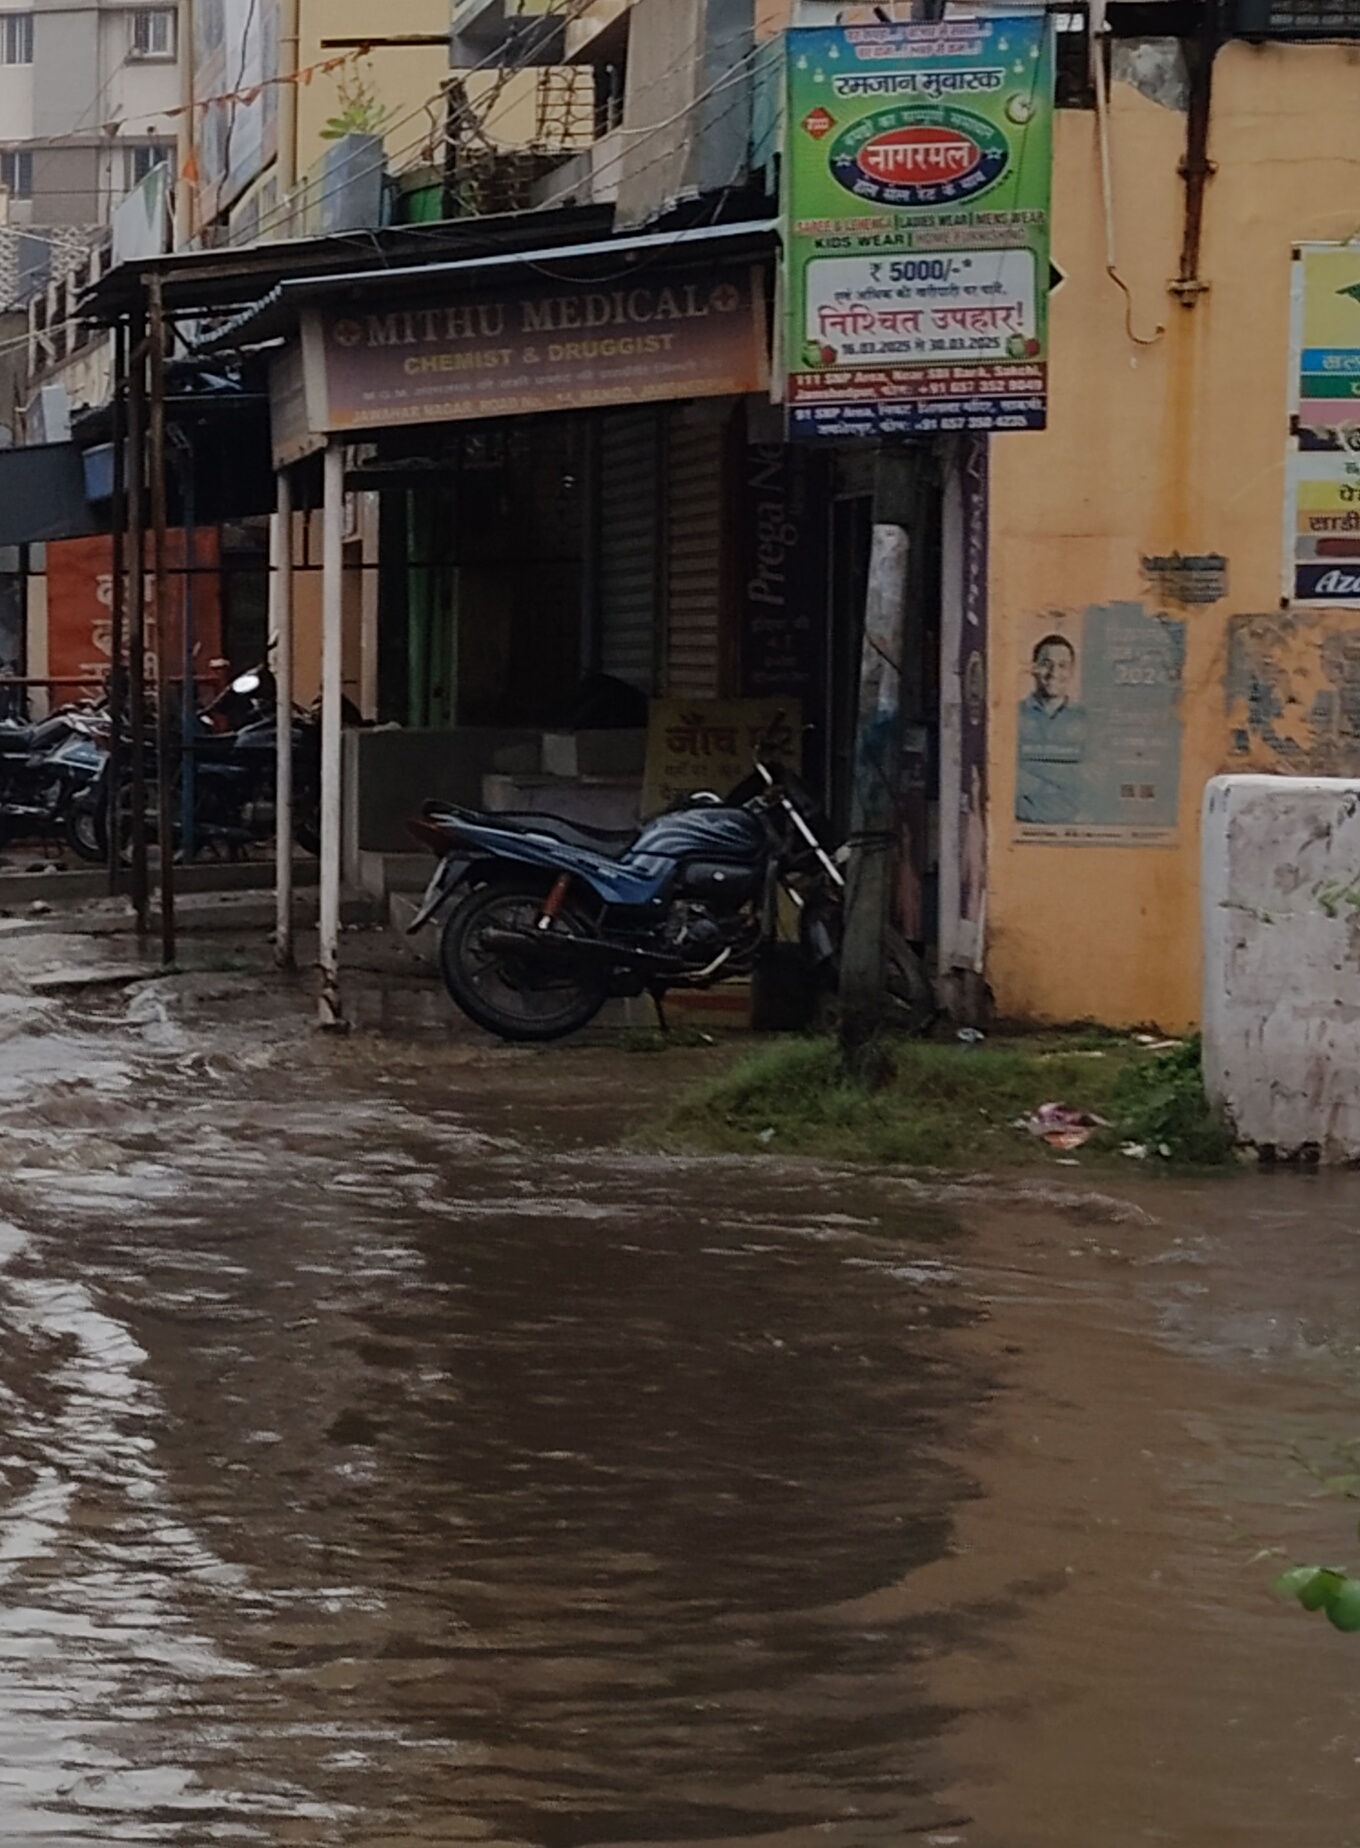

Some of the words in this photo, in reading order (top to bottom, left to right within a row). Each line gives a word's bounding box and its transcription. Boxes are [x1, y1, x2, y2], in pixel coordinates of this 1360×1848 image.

[866, 141, 972, 171] नागरमल
[938, 214, 966, 227] WEAR
[1011, 210, 1045, 224] WEAR
[814, 236, 851, 249] KIDS
[857, 233, 905, 247] WEAR
[365, 302, 505, 348] MITHU
[521, 284, 709, 333] MEDICAL
[818, 303, 924, 338] निश्चित
[930, 301, 1024, 334] उपहार!
[403, 348, 513, 376] CHEMIST
[523, 345, 540, 363] &
[548, 333, 675, 363] DRUGGIST
[747, 501, 799, 607] Prega
